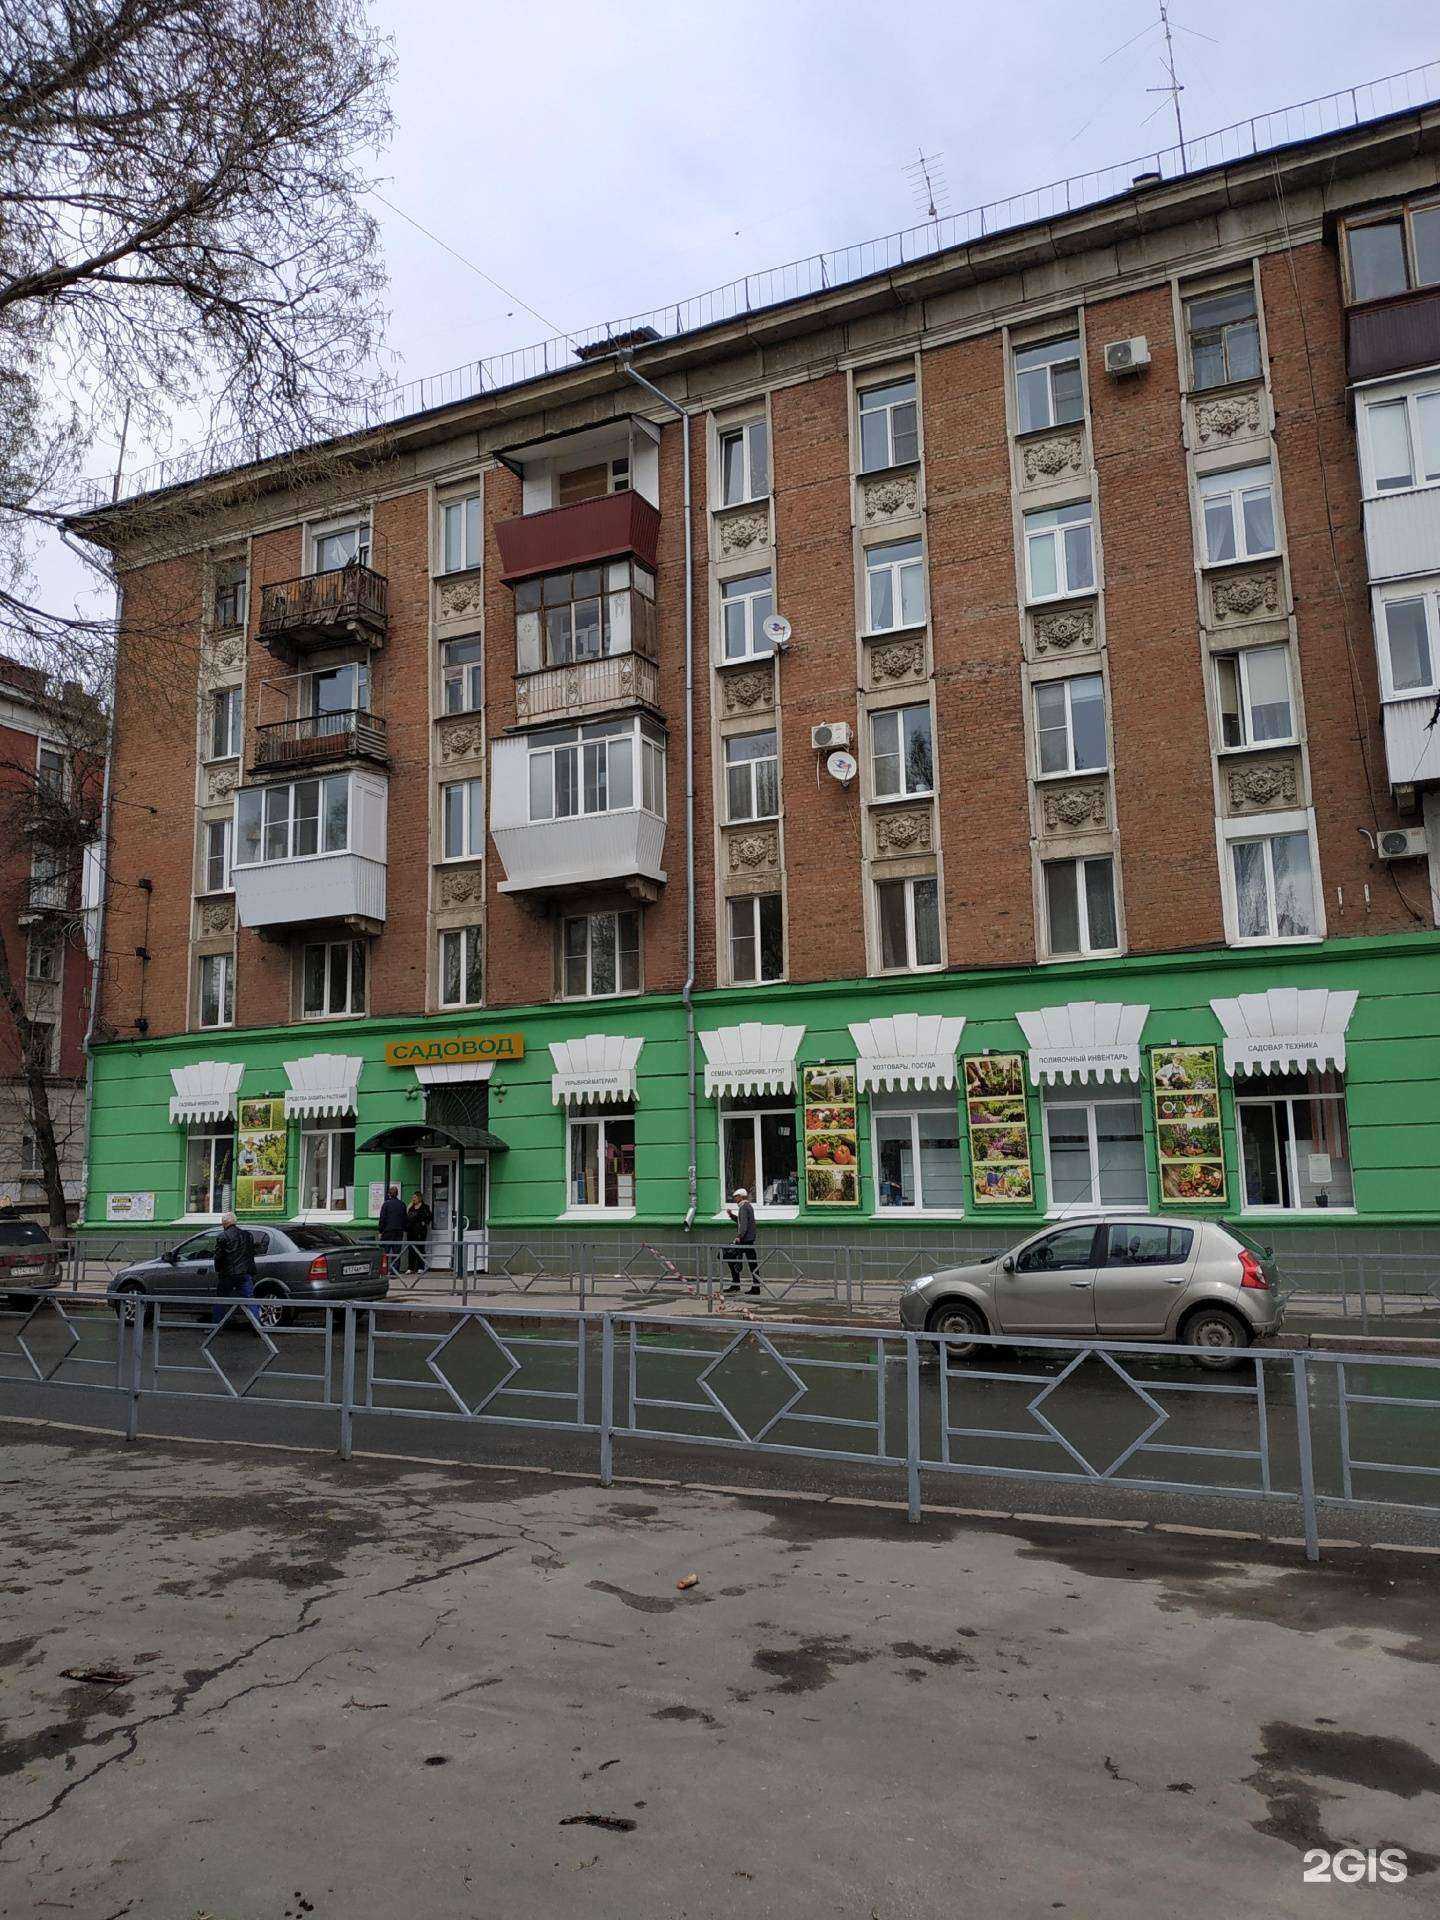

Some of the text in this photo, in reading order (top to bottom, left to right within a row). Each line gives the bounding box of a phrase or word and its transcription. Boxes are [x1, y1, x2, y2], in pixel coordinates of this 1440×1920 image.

[393, 1038, 514, 1060] САДОВОД
[1247, 1041, 1319, 1052] САДОВАЯ ТЕХНИКА
[1039, 1053, 1129, 1064] ПОЛИВОЧНЫЙ ИНВЕНТАРЬ
[911, 1061, 936, 1070] ПОСУДА
